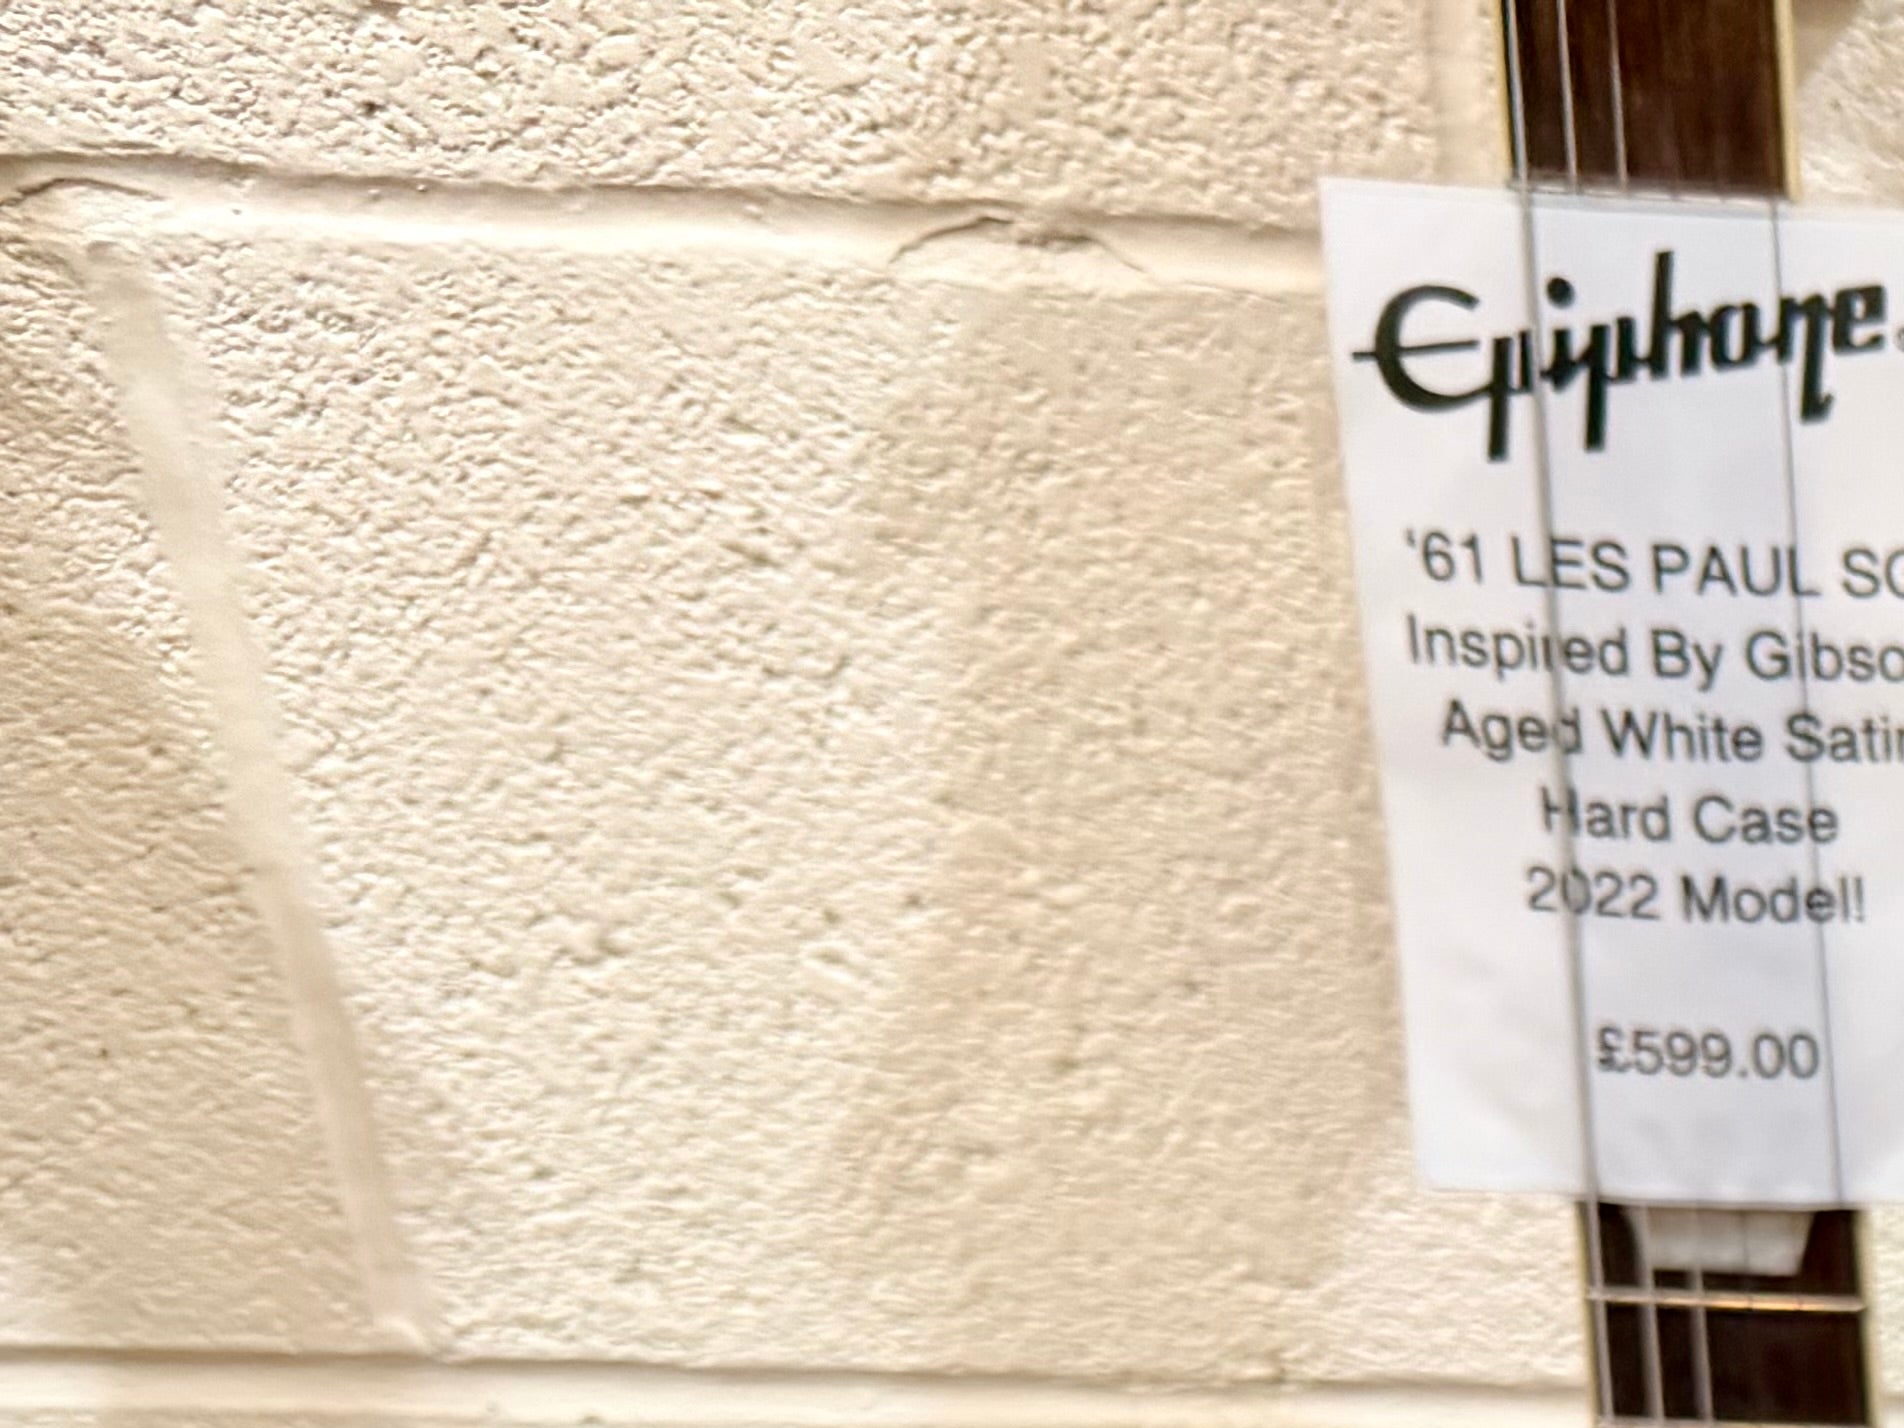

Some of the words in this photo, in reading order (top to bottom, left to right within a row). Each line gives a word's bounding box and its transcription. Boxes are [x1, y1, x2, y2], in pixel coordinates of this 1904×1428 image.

[1510, 535, 1630, 592] LES
[1651, 542, 1821, 597] PAUL
[1407, 612, 1629, 684] Inspired
[1651, 626, 1722, 692] By
[1441, 697, 1582, 763] Aged
[1600, 706, 1763, 762] White
[1541, 784, 1669, 842] Hard
[1693, 794, 1838, 844] Case
[1527, 865, 1660, 920] 2022
[1680, 872, 1865, 924] Model!
[1597, 1026, 1820, 1079] £599.00
